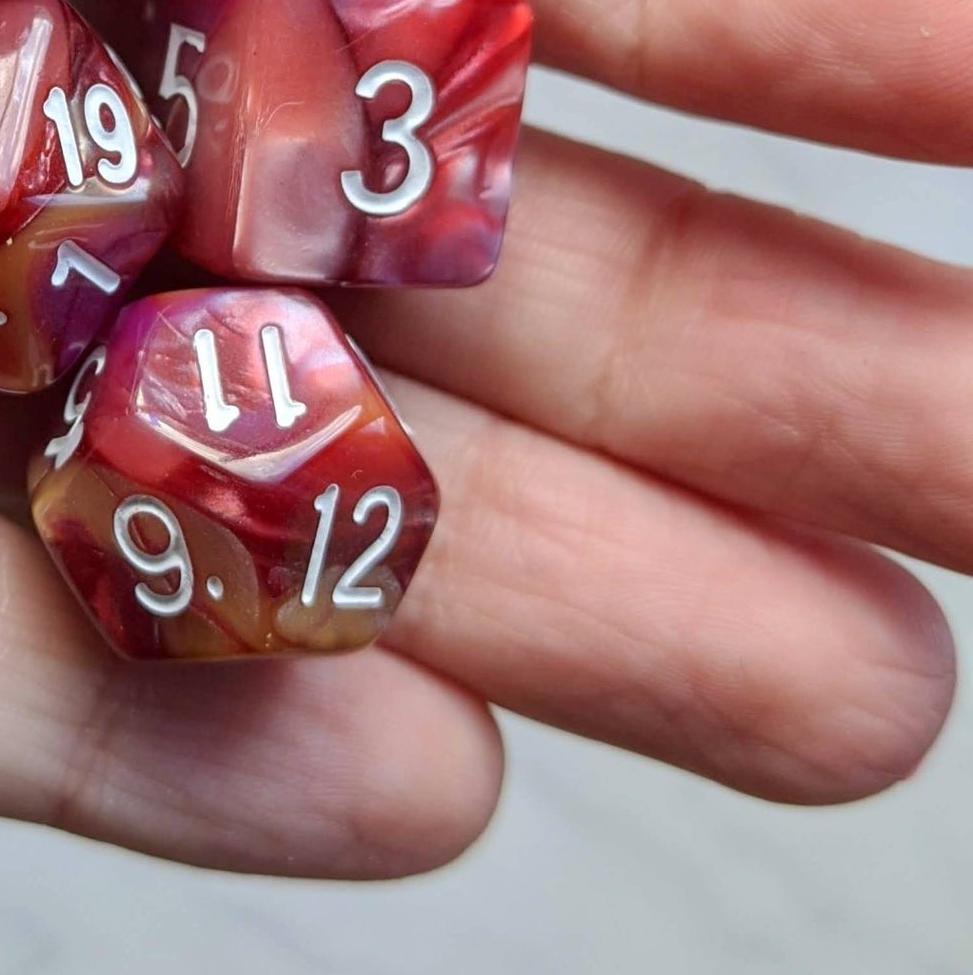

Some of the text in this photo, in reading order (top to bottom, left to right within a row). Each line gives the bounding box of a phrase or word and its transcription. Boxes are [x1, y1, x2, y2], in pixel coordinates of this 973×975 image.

[43, 83, 137, 188] 19
[159, 23, 205, 168] 5
[341, 59, 435, 216] 3
[193, 325, 307, 432] 11
[300, 484, 403, 607] 12
